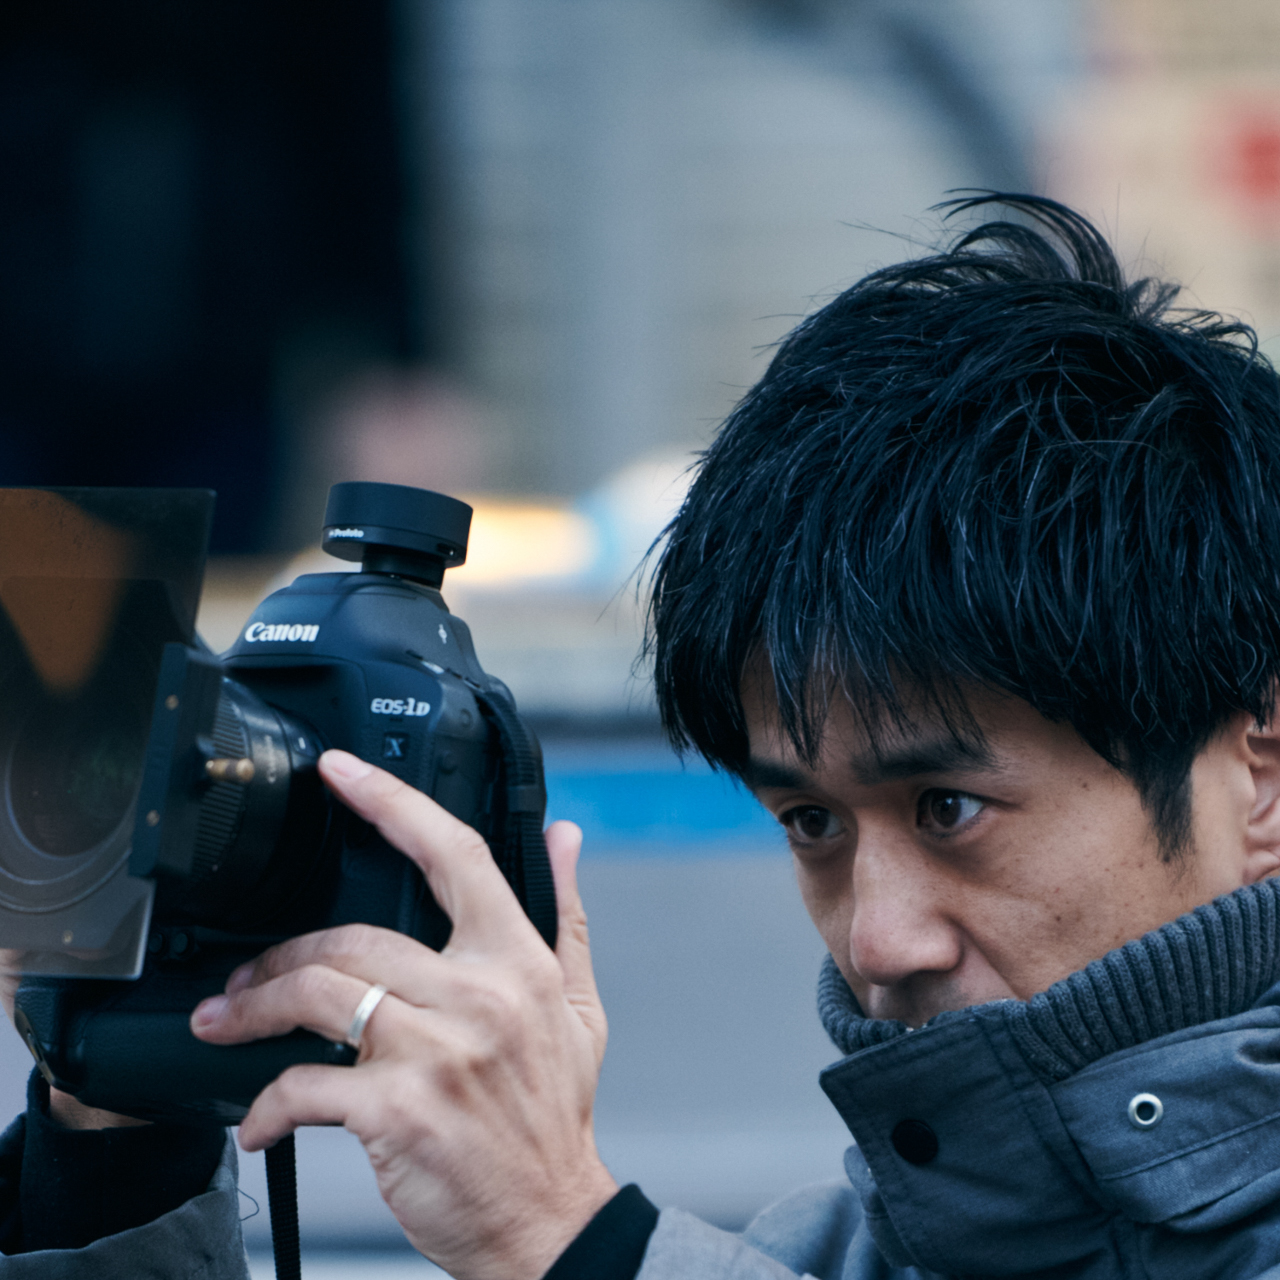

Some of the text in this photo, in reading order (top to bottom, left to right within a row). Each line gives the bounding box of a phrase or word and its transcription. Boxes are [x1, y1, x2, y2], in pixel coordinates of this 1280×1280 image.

[245, 618, 320, 642] Canon
[370, 697, 431, 716] EOS-1D
[384, 736, 404, 757] X
